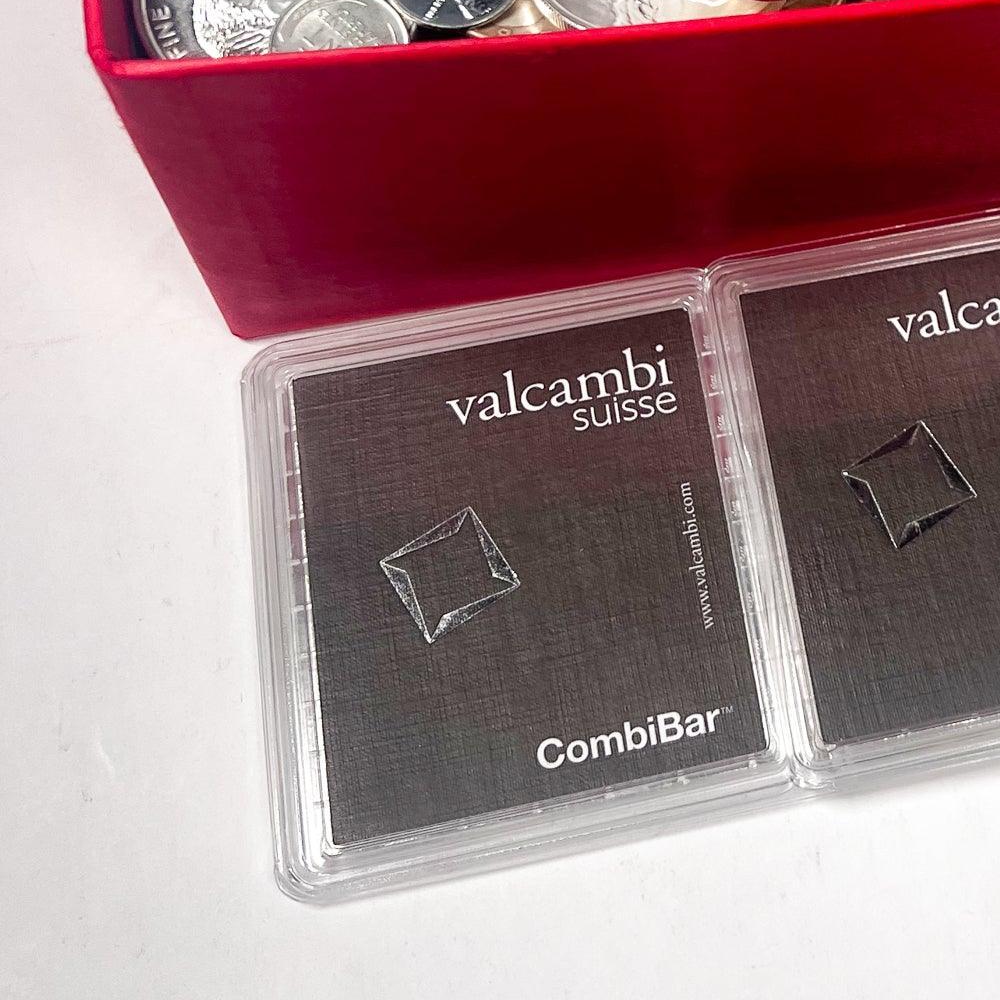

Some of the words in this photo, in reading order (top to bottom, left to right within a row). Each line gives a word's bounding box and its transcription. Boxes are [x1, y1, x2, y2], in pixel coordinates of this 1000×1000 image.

[446, 343, 674, 425] valcambi
[573, 389, 678, 431] suisse
[681, 480, 714, 630] www.valcambi.com
